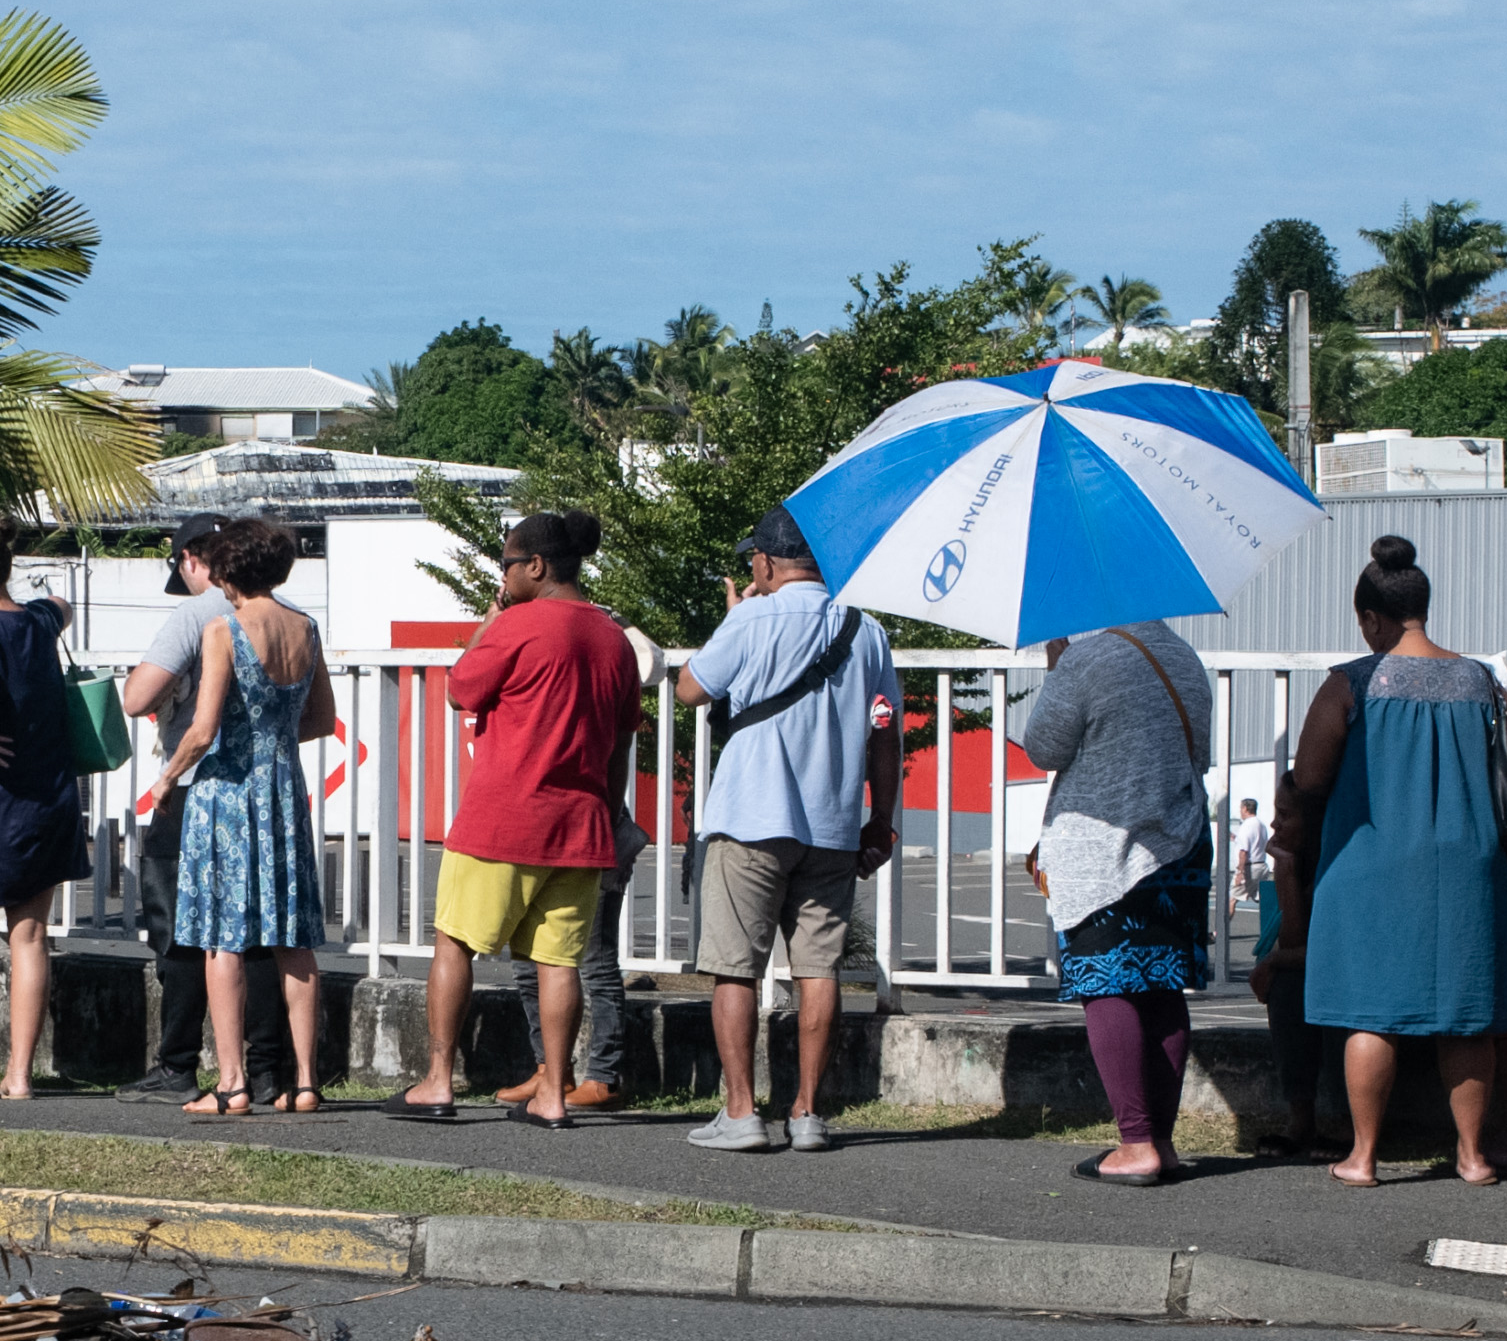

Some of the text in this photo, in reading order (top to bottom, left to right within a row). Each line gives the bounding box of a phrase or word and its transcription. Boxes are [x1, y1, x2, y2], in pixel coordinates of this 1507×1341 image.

[959, 453, 1014, 534] HYUNDAI
[1121, 431, 1262, 550] ROYAL MOTORS
